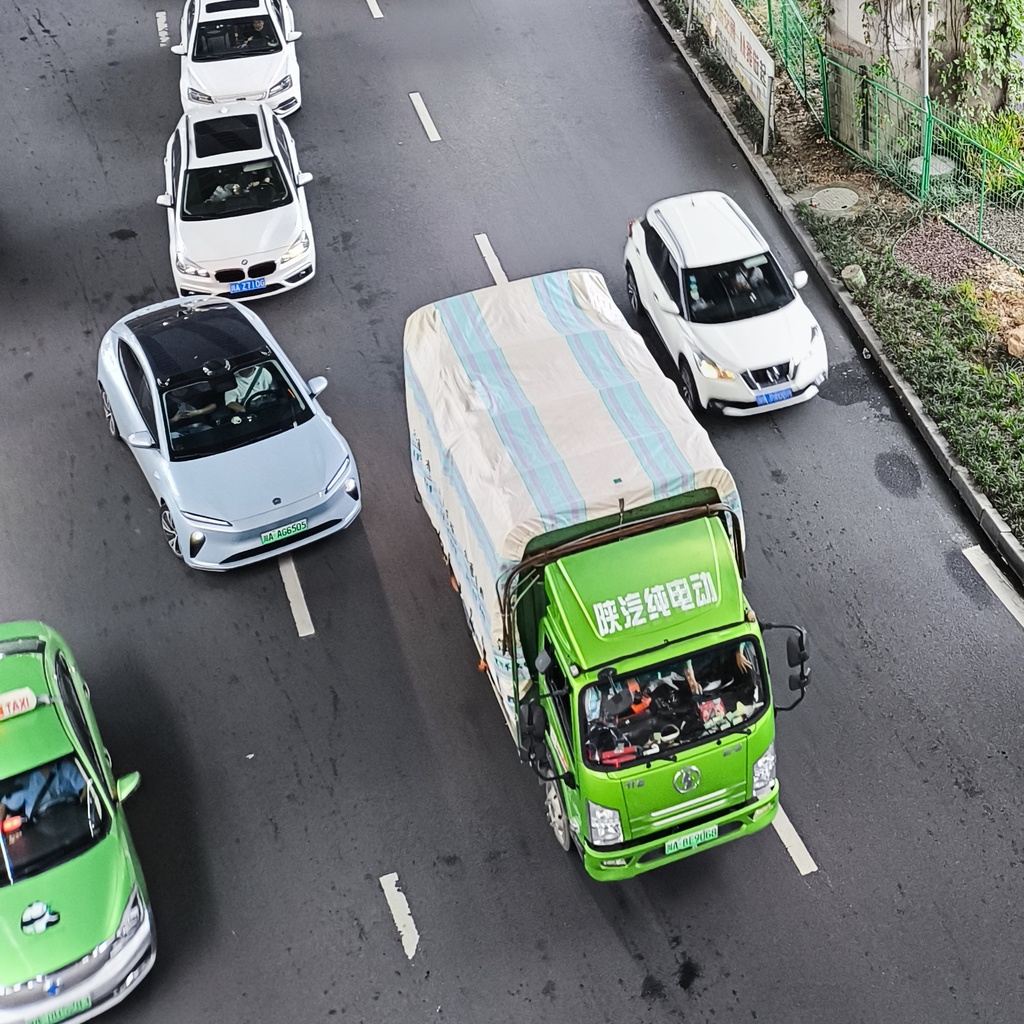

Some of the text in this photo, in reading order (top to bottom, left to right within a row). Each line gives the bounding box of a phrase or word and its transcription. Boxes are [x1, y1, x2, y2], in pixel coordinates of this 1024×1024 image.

[593, 571, 718, 637] 陕汽纯电动
[5, 697, 30, 716] TAXI
